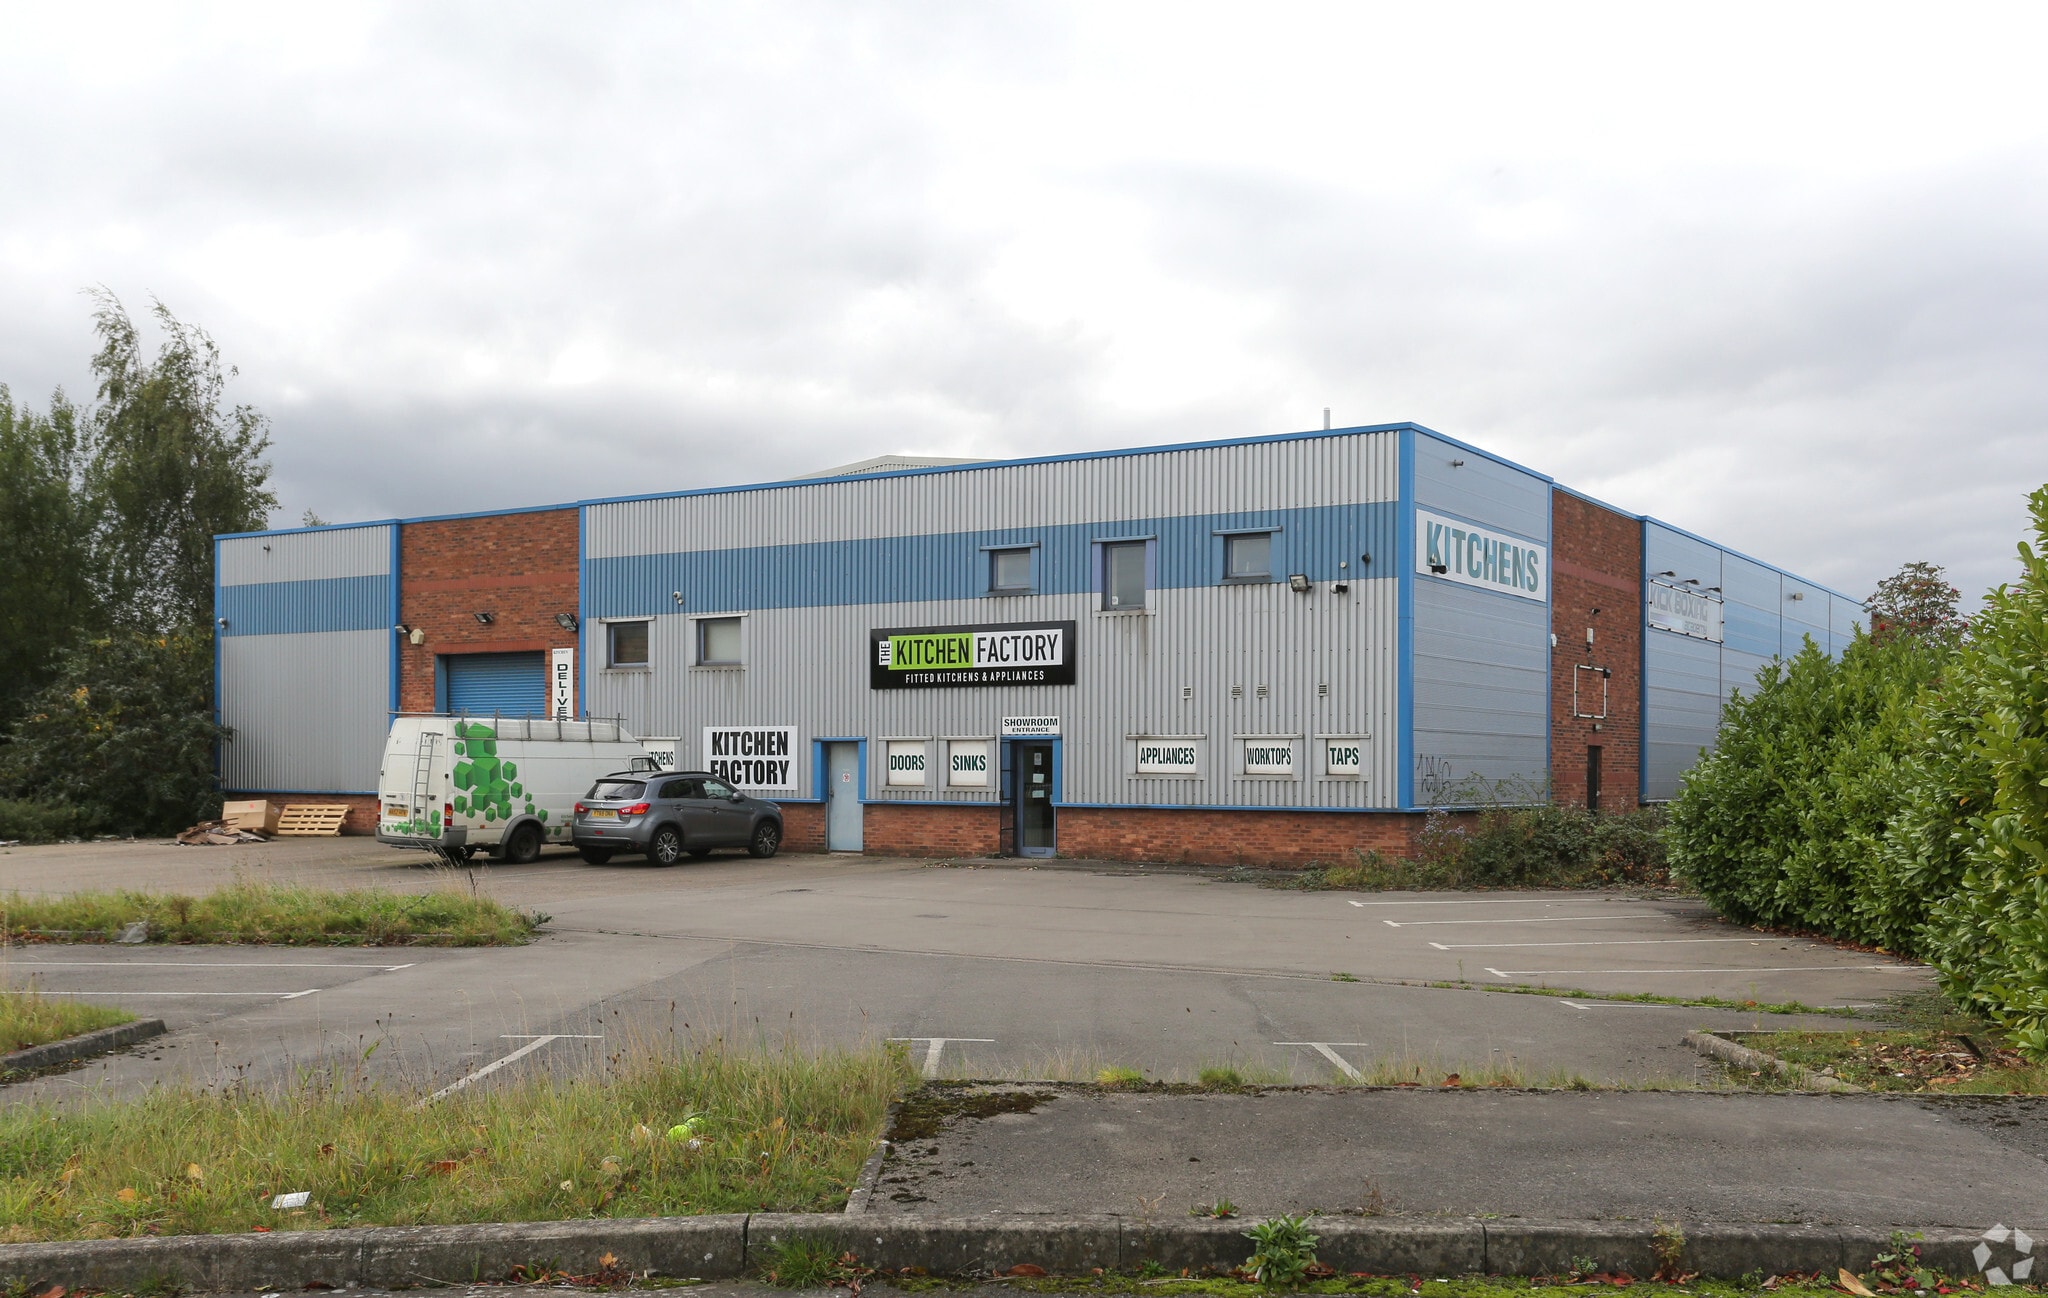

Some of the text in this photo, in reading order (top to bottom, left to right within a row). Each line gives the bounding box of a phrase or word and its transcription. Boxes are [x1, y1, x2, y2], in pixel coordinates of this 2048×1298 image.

[1426, 520, 1539, 593] KITCHENS
[1650, 582, 1708, 622] KICK BOXING
[880, 642, 891, 663] THE
[896, 634, 1059, 666] KITCHEN FACTORY
[905, 670, 1045, 684] FITTED KITCHENS & APPLIANCES
[1004, 718, 1058, 727] SHOWROOM
[711, 731, 789, 756] KITCHEN
[890, 754, 925, 771] DOORS
[952, 754, 986, 772] SINKS
[1139, 747, 1195, 765] APPLIANCES
[1246, 747, 1292, 766] WORKTOPS
[1329, 747, 1360, 766] TAPS
[710, 759, 790, 785] FACTORY
